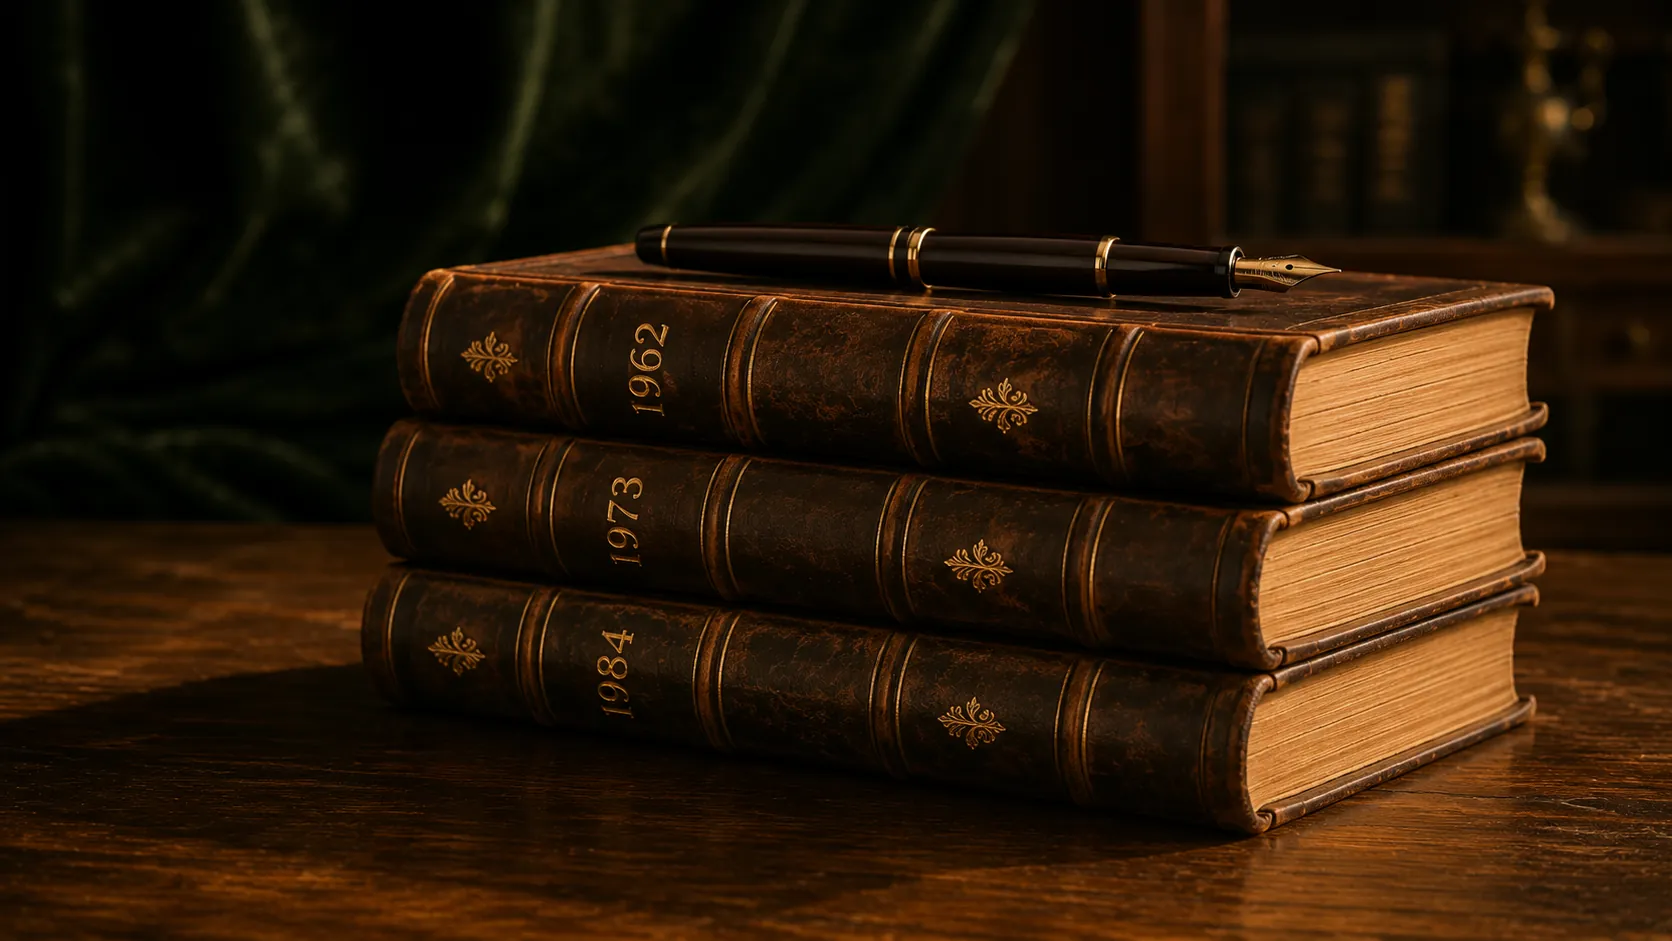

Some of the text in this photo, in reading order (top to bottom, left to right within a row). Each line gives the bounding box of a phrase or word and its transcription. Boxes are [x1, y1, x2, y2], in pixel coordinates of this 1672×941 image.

[629, 323, 670, 416] 1962
[607, 477, 643, 567] 1973
[597, 629, 635, 719] 1984
